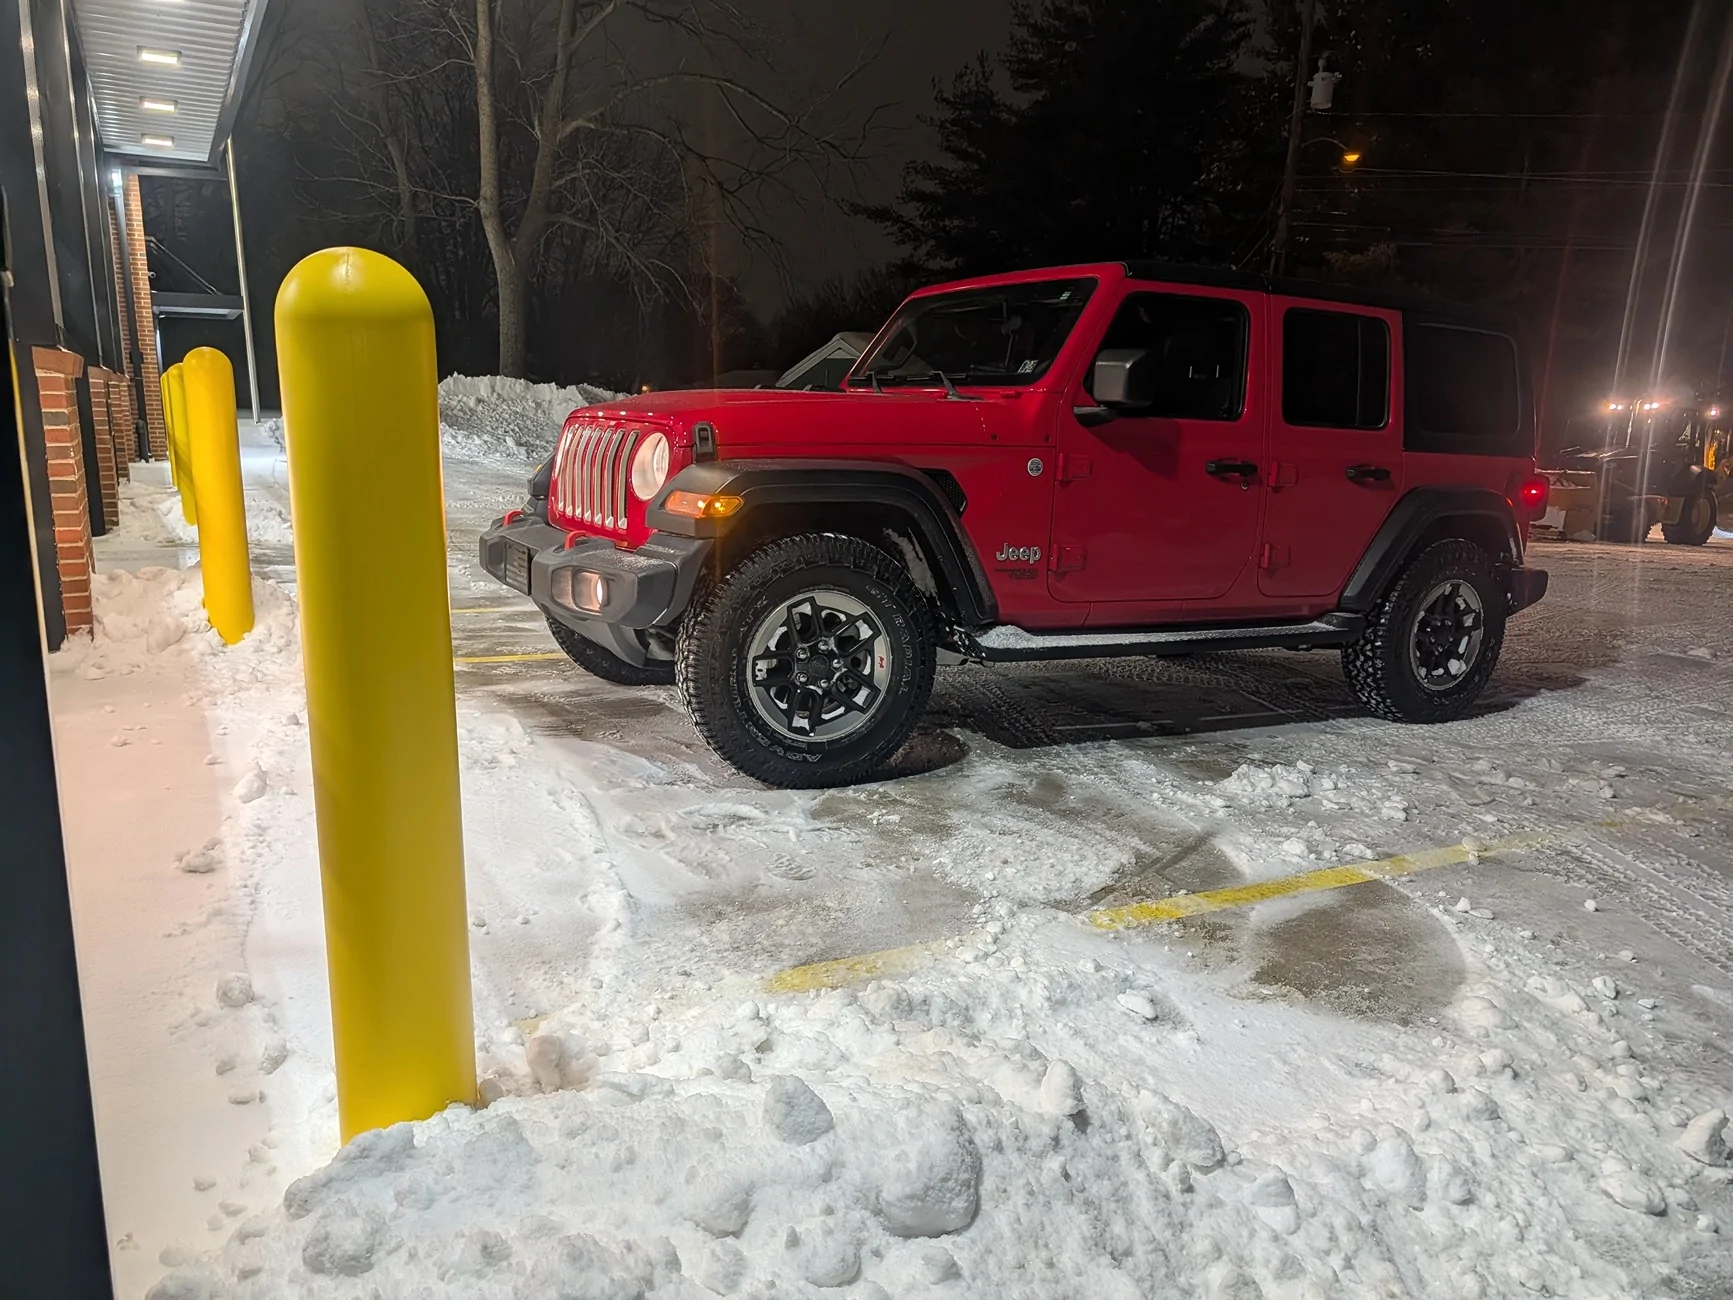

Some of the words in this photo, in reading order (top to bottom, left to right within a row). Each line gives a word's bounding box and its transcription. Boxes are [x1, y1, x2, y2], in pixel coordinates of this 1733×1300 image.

[995, 542, 1041, 564] Jeep
[892, 613, 914, 695] RADIAL
[729, 648, 824, 763] ADVENTURO
